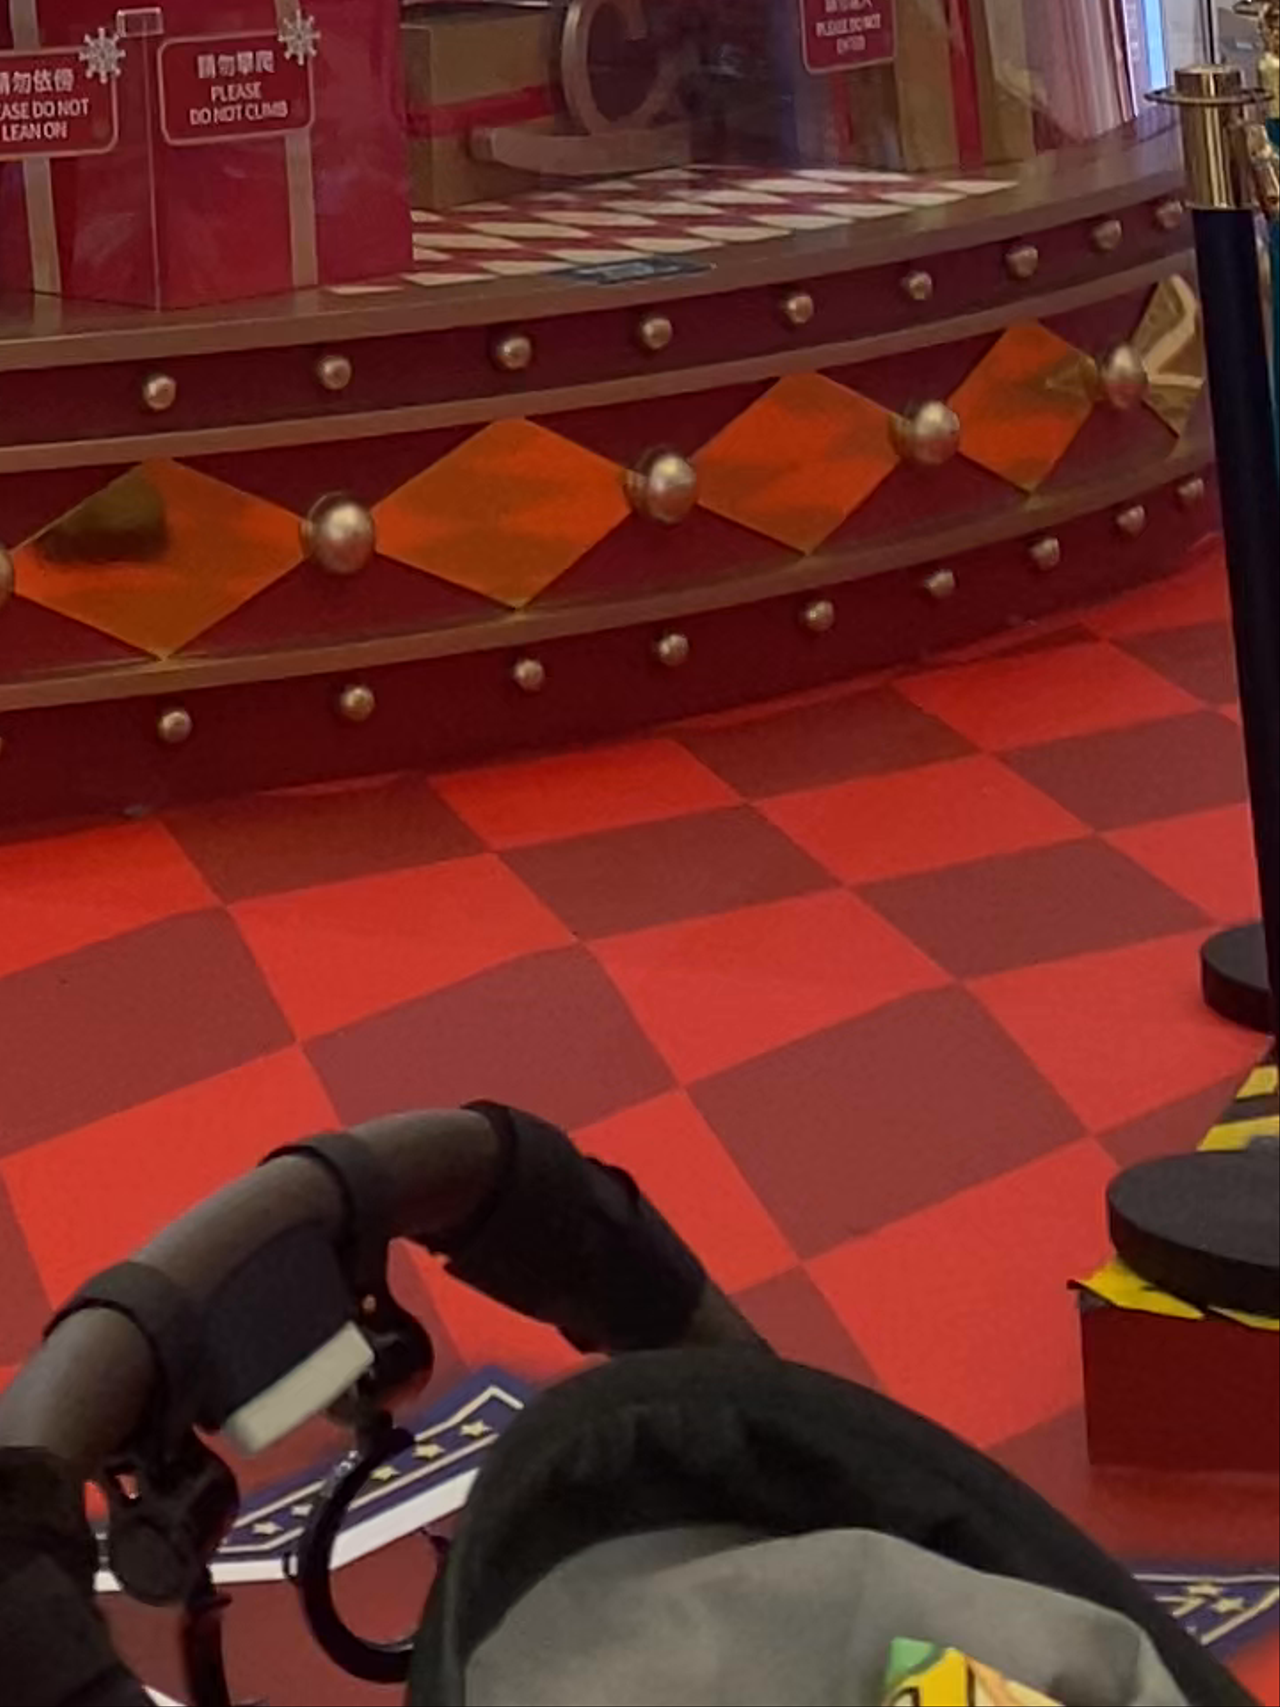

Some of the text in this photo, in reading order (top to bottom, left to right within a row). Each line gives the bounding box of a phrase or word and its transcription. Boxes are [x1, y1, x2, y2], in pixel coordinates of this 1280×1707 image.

[210, 82, 262, 102] PLEASE
[32, 100, 56, 119] DO
[57, 98, 90, 117] NOT
[190, 100, 289, 126] DO NOT CLIMB
[2, 122, 67, 141] LEAN ON
